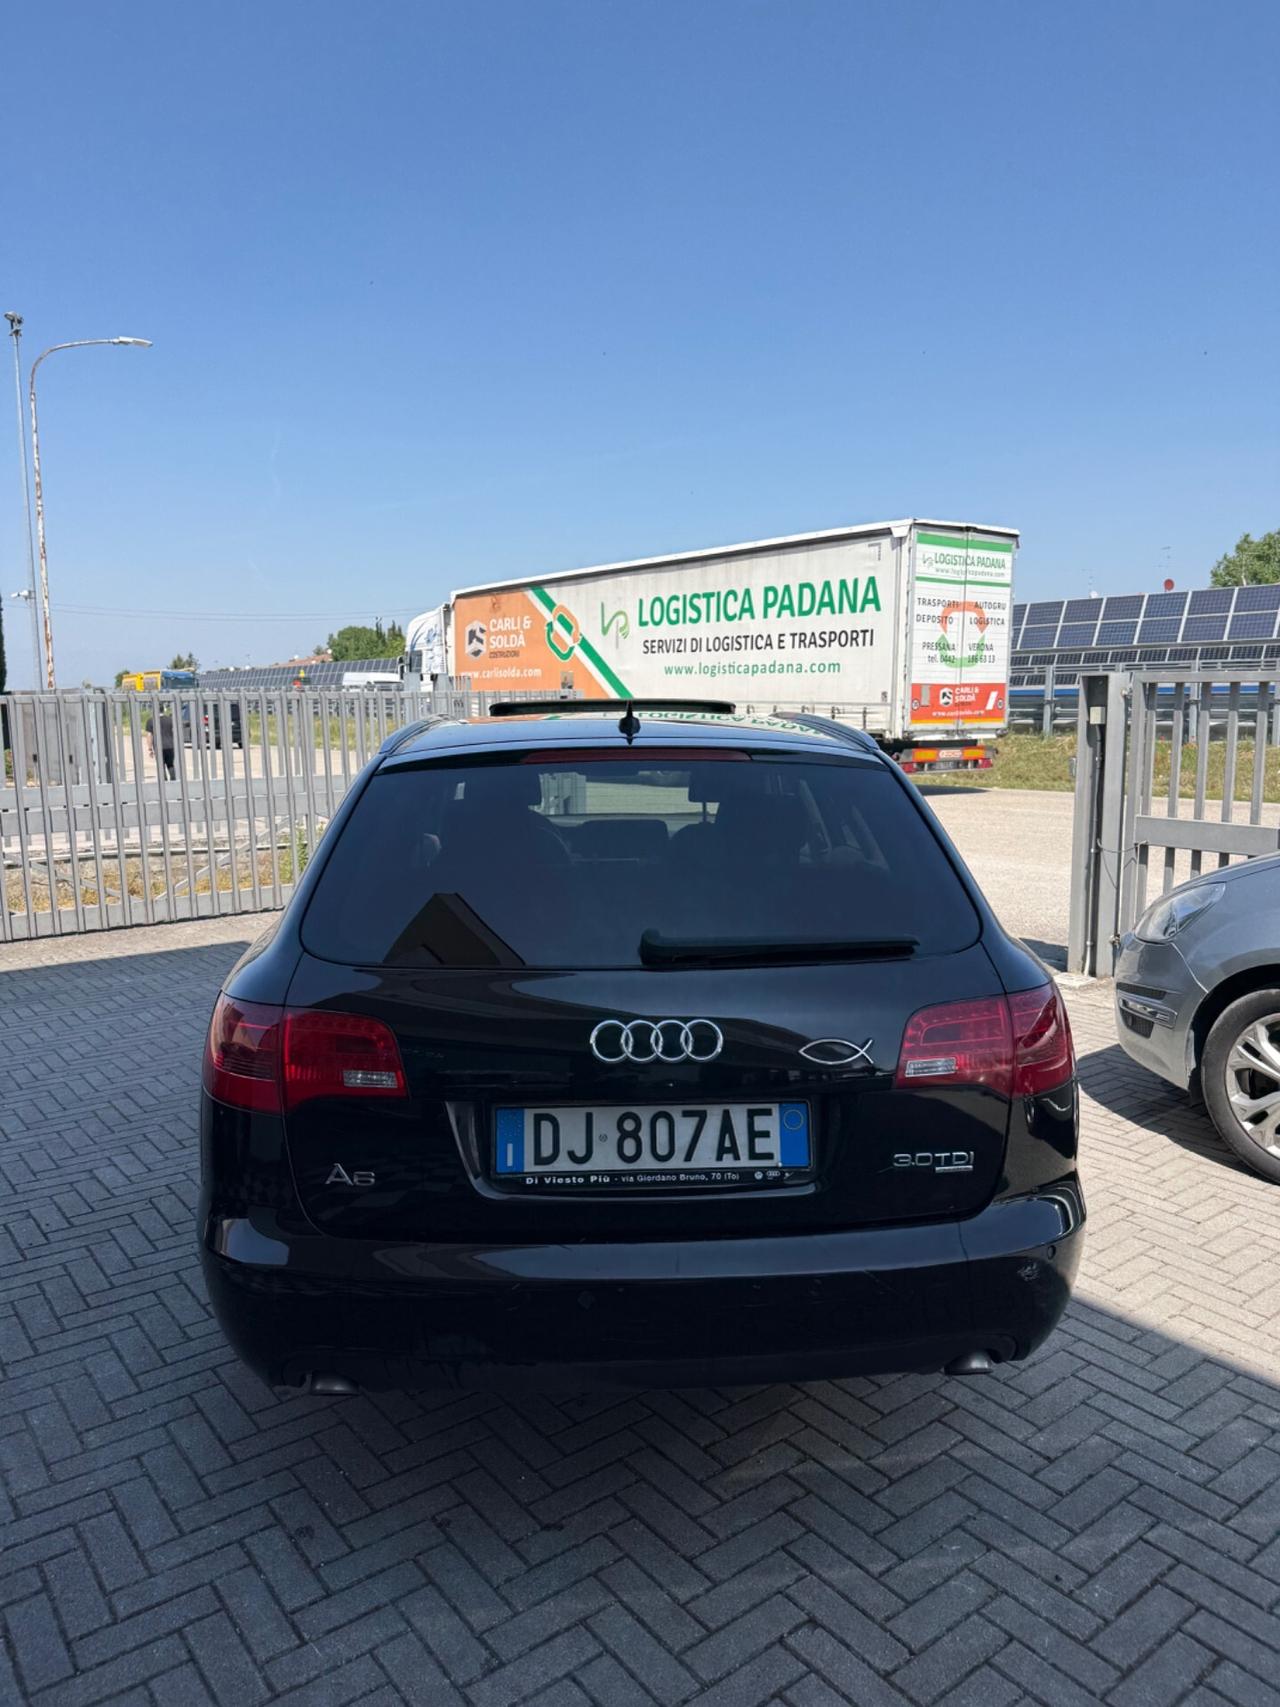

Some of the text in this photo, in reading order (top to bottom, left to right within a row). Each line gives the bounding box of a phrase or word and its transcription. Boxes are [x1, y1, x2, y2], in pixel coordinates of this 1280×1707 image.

[934, 552, 975, 567] LOGISTICA
[977, 556, 1006, 570] PADANA
[638, 588, 755, 627] LOGISTICA
[763, 576, 881, 619] PADANA
[917, 597, 1006, 611] TRASPORTI AUTOGRU
[489, 615, 532, 632] CARLI &
[916, 614, 1005, 626] DEPOSITO LOGISTICA
[489, 630, 526, 649] SOLDÀ
[643, 629, 874, 654] SERVIZI DI LOGISTICA E TRASPORTI
[968, 643, 994, 652] VERONA
[664, 660, 841, 677] www.logisticapadana.com
[507, 1108, 775, 1167] I DJ 807AE
[324, 1162, 376, 1186] A6
[544, 1176, 585, 1184] Viesto
[590, 1175, 610, 1183] Più
[637, 1174, 677, 1182] Giordano
[680, 1173, 708, 1181] Bruno,
[711, 1172, 721, 1180] 70
[724, 1172, 740, 1181] (To)
